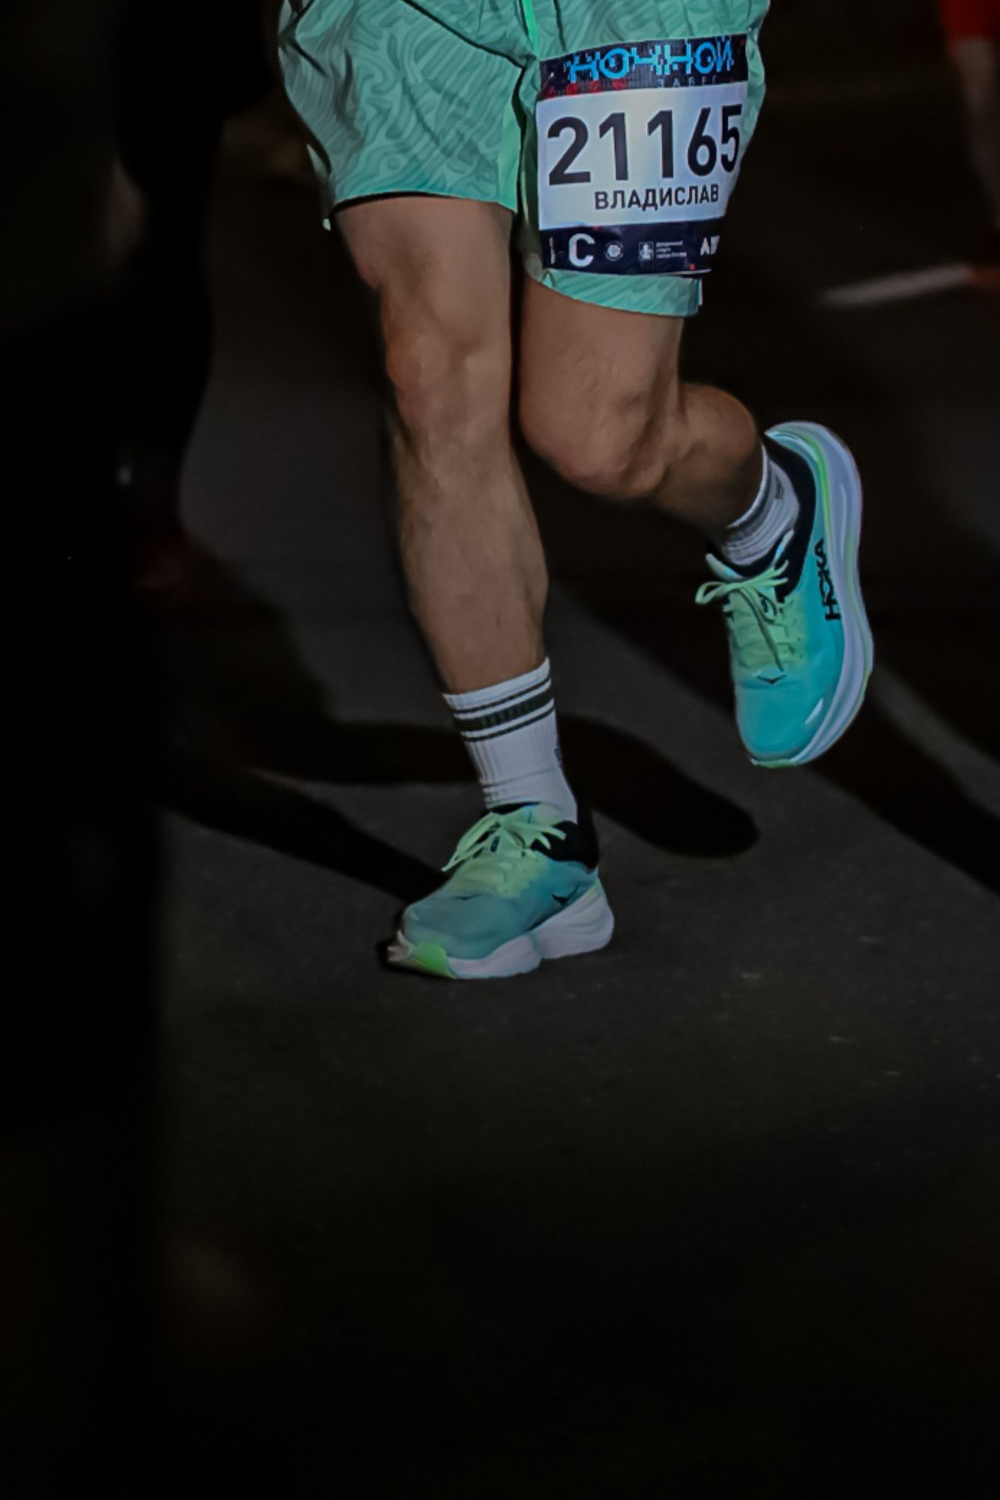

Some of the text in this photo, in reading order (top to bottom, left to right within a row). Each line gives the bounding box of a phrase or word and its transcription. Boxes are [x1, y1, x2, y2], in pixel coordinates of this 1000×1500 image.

[564, 36, 735, 84] НОЧНОЙ
[547, 104, 742, 186] 21165
[594, 184, 720, 211] ВЛАДИСЛАВ
[814, 537, 841, 621] HOKA
